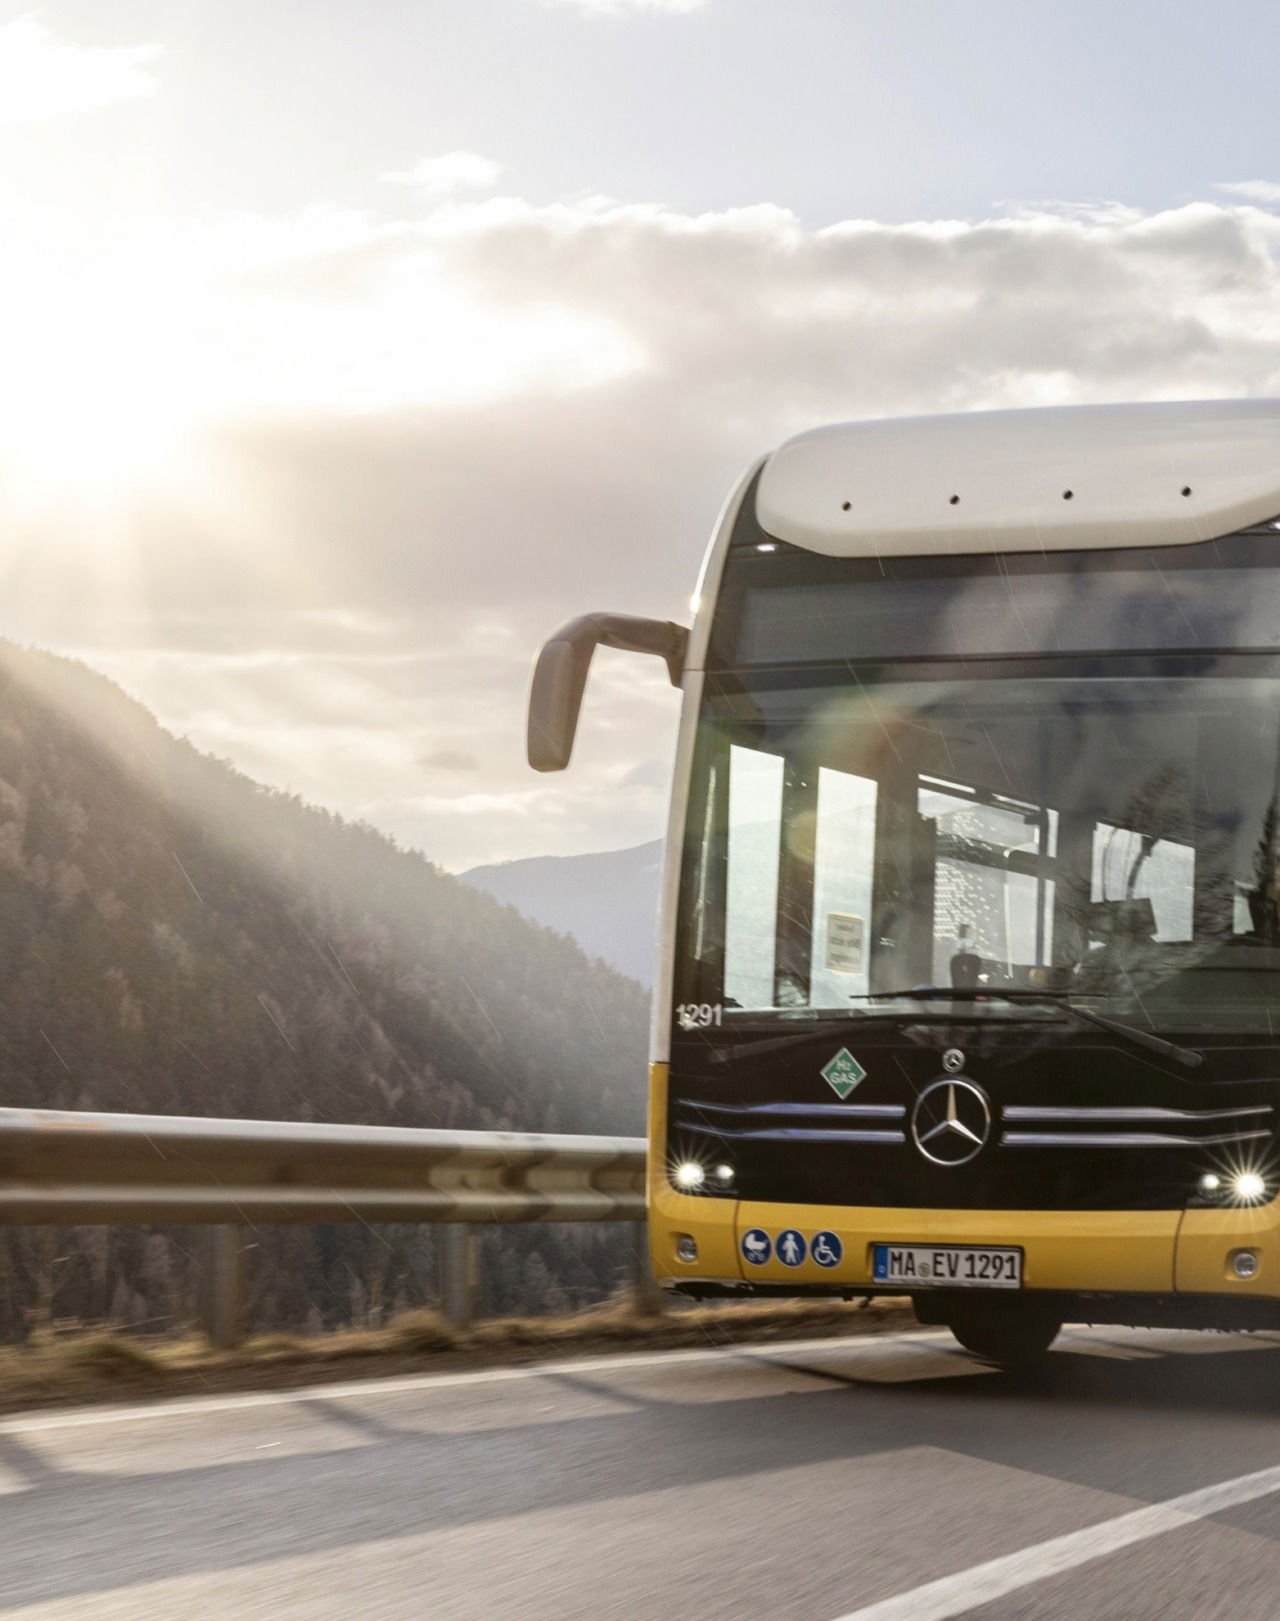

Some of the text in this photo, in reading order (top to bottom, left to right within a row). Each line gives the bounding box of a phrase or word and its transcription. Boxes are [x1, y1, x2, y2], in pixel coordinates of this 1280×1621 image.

[676, 1003, 723, 1027] 1291
[830, 1072, 858, 1085] GAS
[890, 1251, 1017, 1280] MA EV 1291
